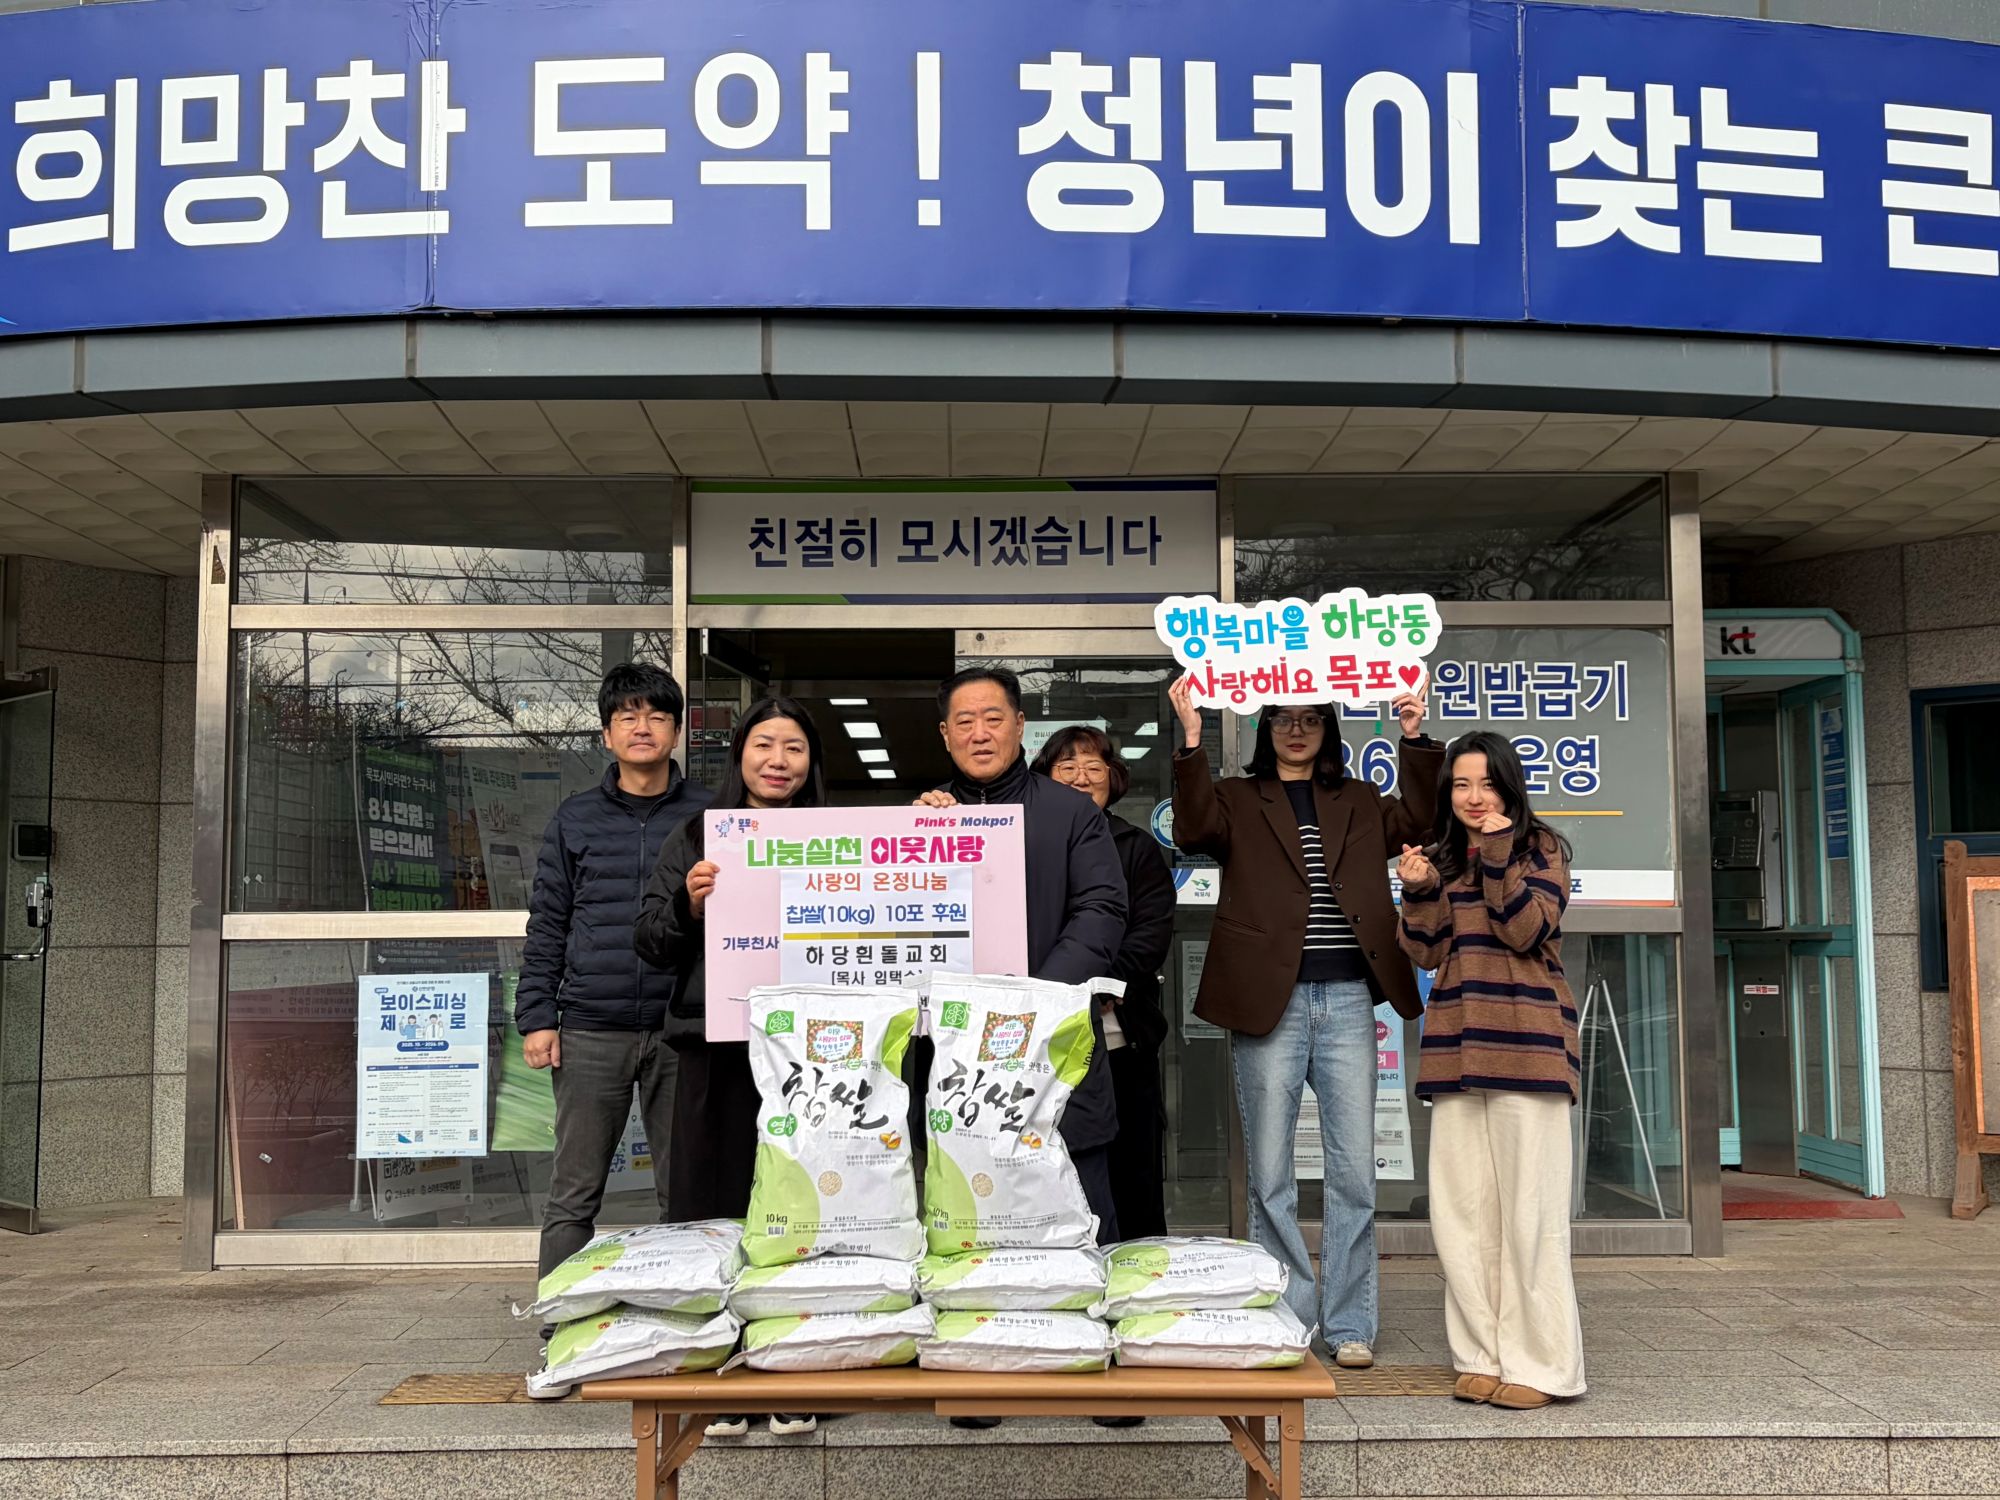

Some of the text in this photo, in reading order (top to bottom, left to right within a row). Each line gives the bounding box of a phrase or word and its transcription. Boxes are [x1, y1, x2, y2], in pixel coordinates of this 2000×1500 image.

[9, 51, 2000, 277] 희망찬 도약 ! 청년이 찾는 큰
[748, 515, 1162, 568] 친절히 모시겠습니다
[1165, 598, 1430, 659] 행복마을 하당동
[1720, 626, 1756, 655] kt
[1186, 654, 1397, 704] 사랑해요 목포
[1340, 660, 1629, 721] 원발급기
[1508, 735, 1601, 797] 운영
[914, 815, 1015, 828] Pink's Mokpo!
[746, 835, 986, 867] 나눔실천 이웃사랑
[804, 871, 949, 892] 사랑의 온정나눔
[786, 903, 967, 925] 찹쌀(10kg) 10포 후원
[722, 936, 780, 951] 기부천사
[380, 993, 467, 1011] 보이스피싱
[380, 1013, 466, 1031] 제 로
